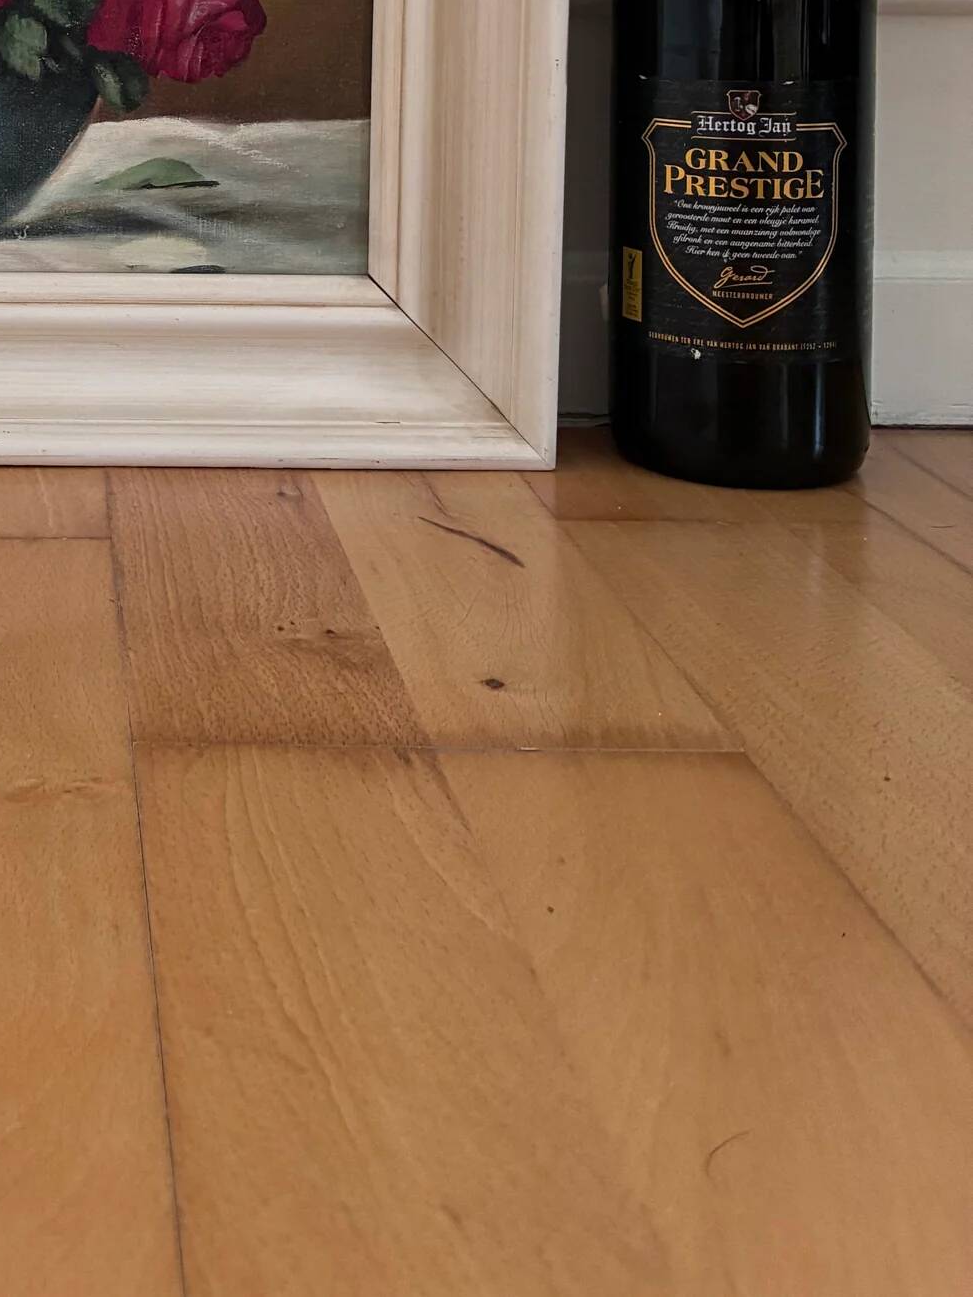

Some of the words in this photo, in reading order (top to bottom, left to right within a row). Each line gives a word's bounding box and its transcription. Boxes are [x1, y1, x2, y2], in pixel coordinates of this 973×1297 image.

[697, 115, 757, 135] Hertog
[759, 117, 792, 137] Jan
[685, 147, 804, 173] GRAND
[663, 164, 825, 200] PRESTIGE
